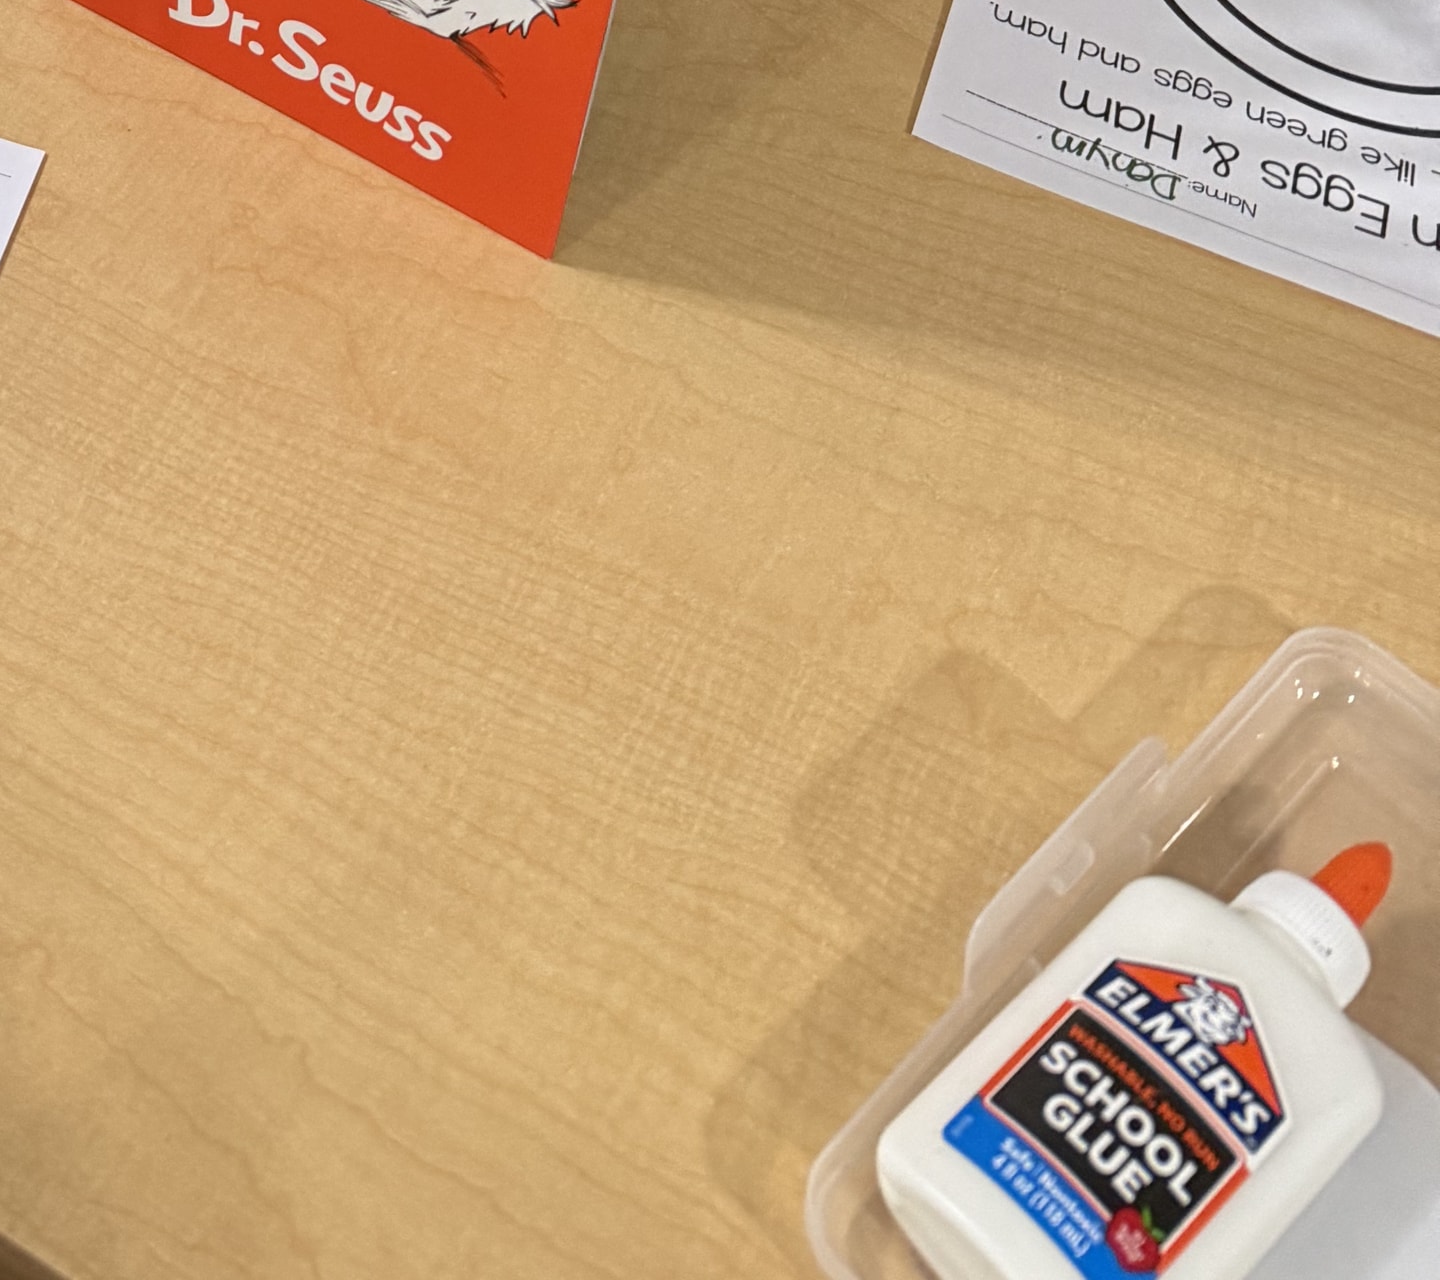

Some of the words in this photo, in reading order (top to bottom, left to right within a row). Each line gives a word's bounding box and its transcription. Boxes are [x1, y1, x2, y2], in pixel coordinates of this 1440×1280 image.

[271, 20, 452, 161] Seuss
[1079, 38, 1142, 77] and
[1153, 66, 1234, 109] eggs
[1058, 78, 1185, 160] Ham
[1245, 99, 1350, 153] green
[1202, 134, 1240, 178] &
[1360, 143, 1416, 187] like
[1186, 178, 1259, 218] Name:
[1260, 157, 1392, 240] Eggs
[1095, 976, 1271, 1134] ELMER'S
[1039, 1041, 1199, 1207] SCHOOL
[1042, 1093, 1154, 1204] GLUE
[1157, 1101, 1186, 1133] NO
[1183, 1128, 1220, 1172] RUN
